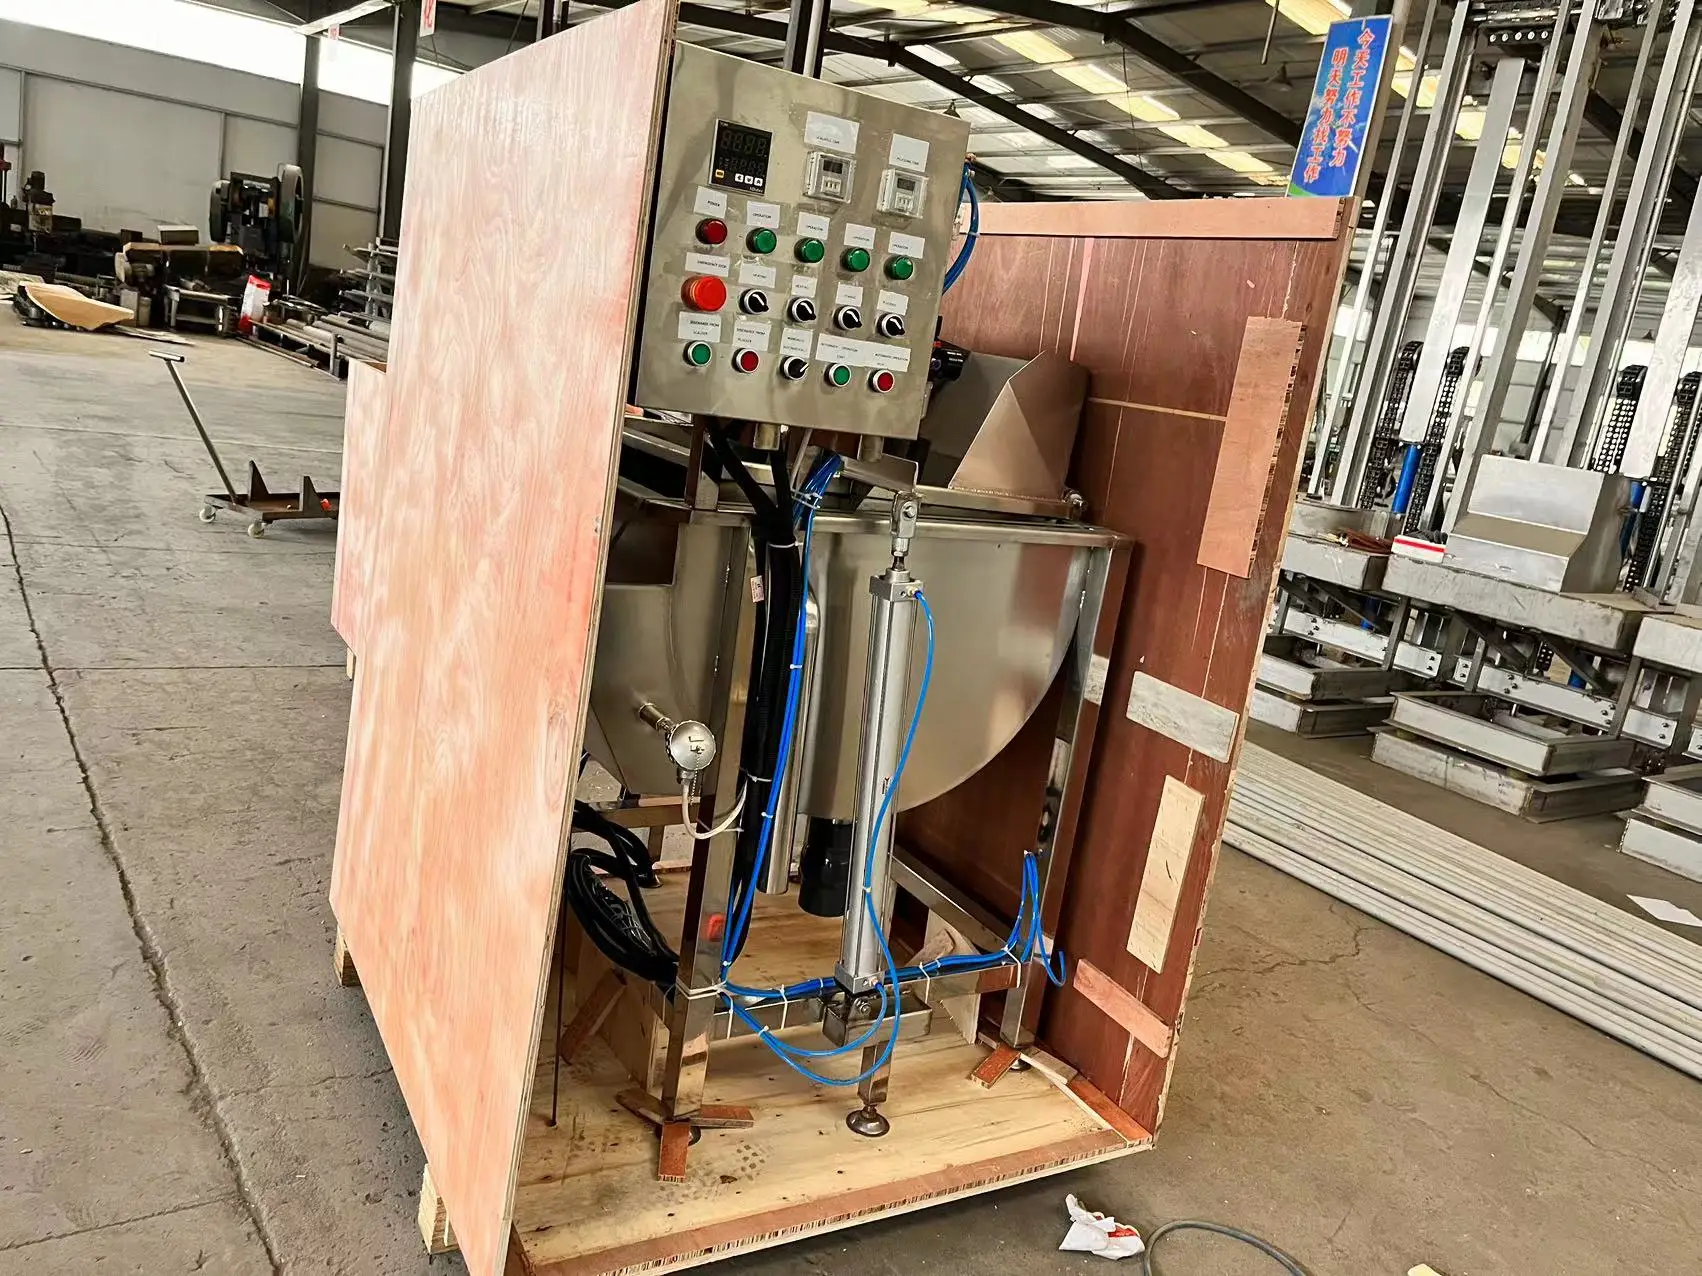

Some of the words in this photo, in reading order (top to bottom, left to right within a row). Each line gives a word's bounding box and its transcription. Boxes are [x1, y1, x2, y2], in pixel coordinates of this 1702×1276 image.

[1303, 46, 1349, 185] 明天努力找工作
[1329, 27, 1375, 168] 今天工作不努力
